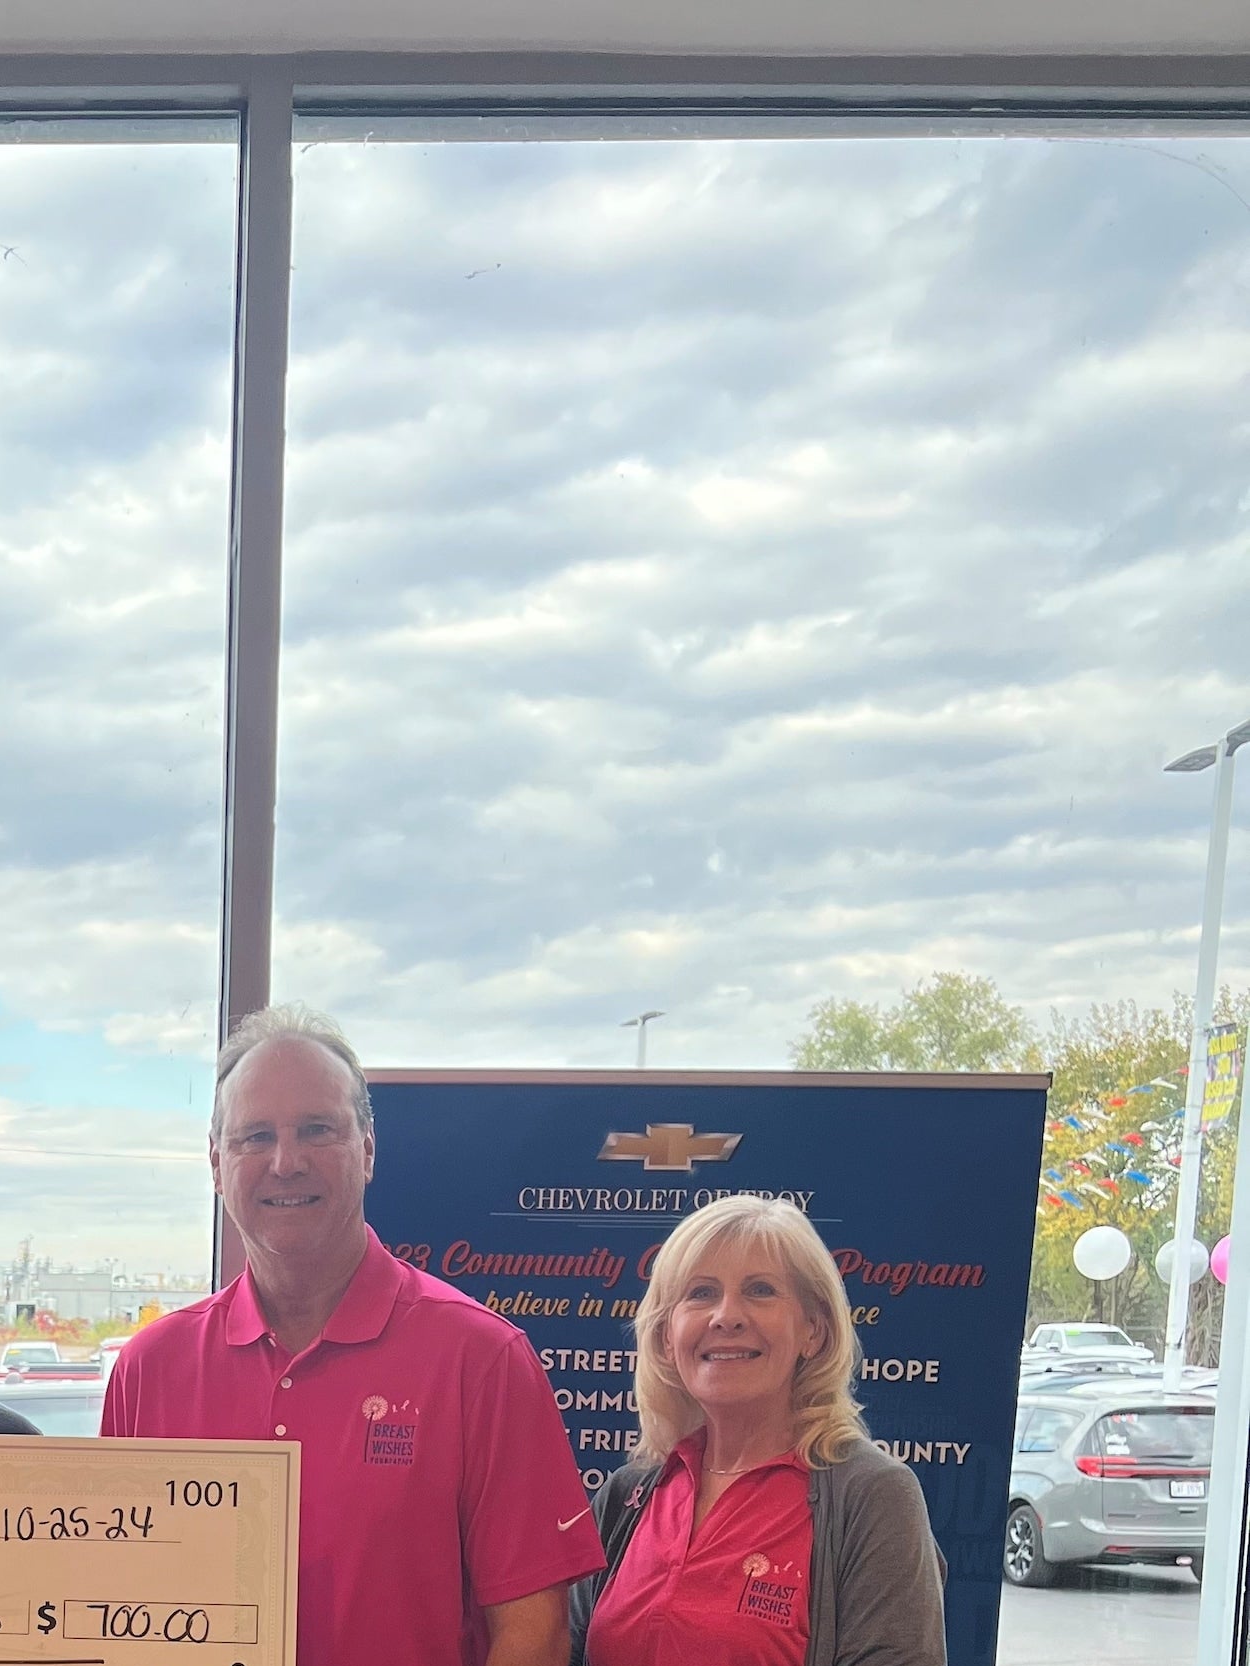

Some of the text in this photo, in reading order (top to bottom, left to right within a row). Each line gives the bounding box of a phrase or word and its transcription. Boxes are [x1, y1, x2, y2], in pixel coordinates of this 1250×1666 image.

[518, 1186, 688, 1212] CHEVROLET
[442, 1239, 626, 1288] Community
[829, 1248, 987, 1296] Program
[485, 1290, 570, 1317] believe
[578, 1292, 600, 1318] in
[539, 1348, 638, 1372] STREET
[861, 1358, 940, 1383] HOPE
[553, 1388, 639, 1413] OMMU
[374, 1424, 417, 1439] BREAST
[579, 1429, 638, 1451] FRIE
[372, 1441, 414, 1456] WISHES
[165, 1480, 240, 1508] 1001
[2, 1506, 154, 1542] 10-25-24
[751, 1580, 798, 1600] BREAST
[747, 1595, 792, 1617] WISHES
